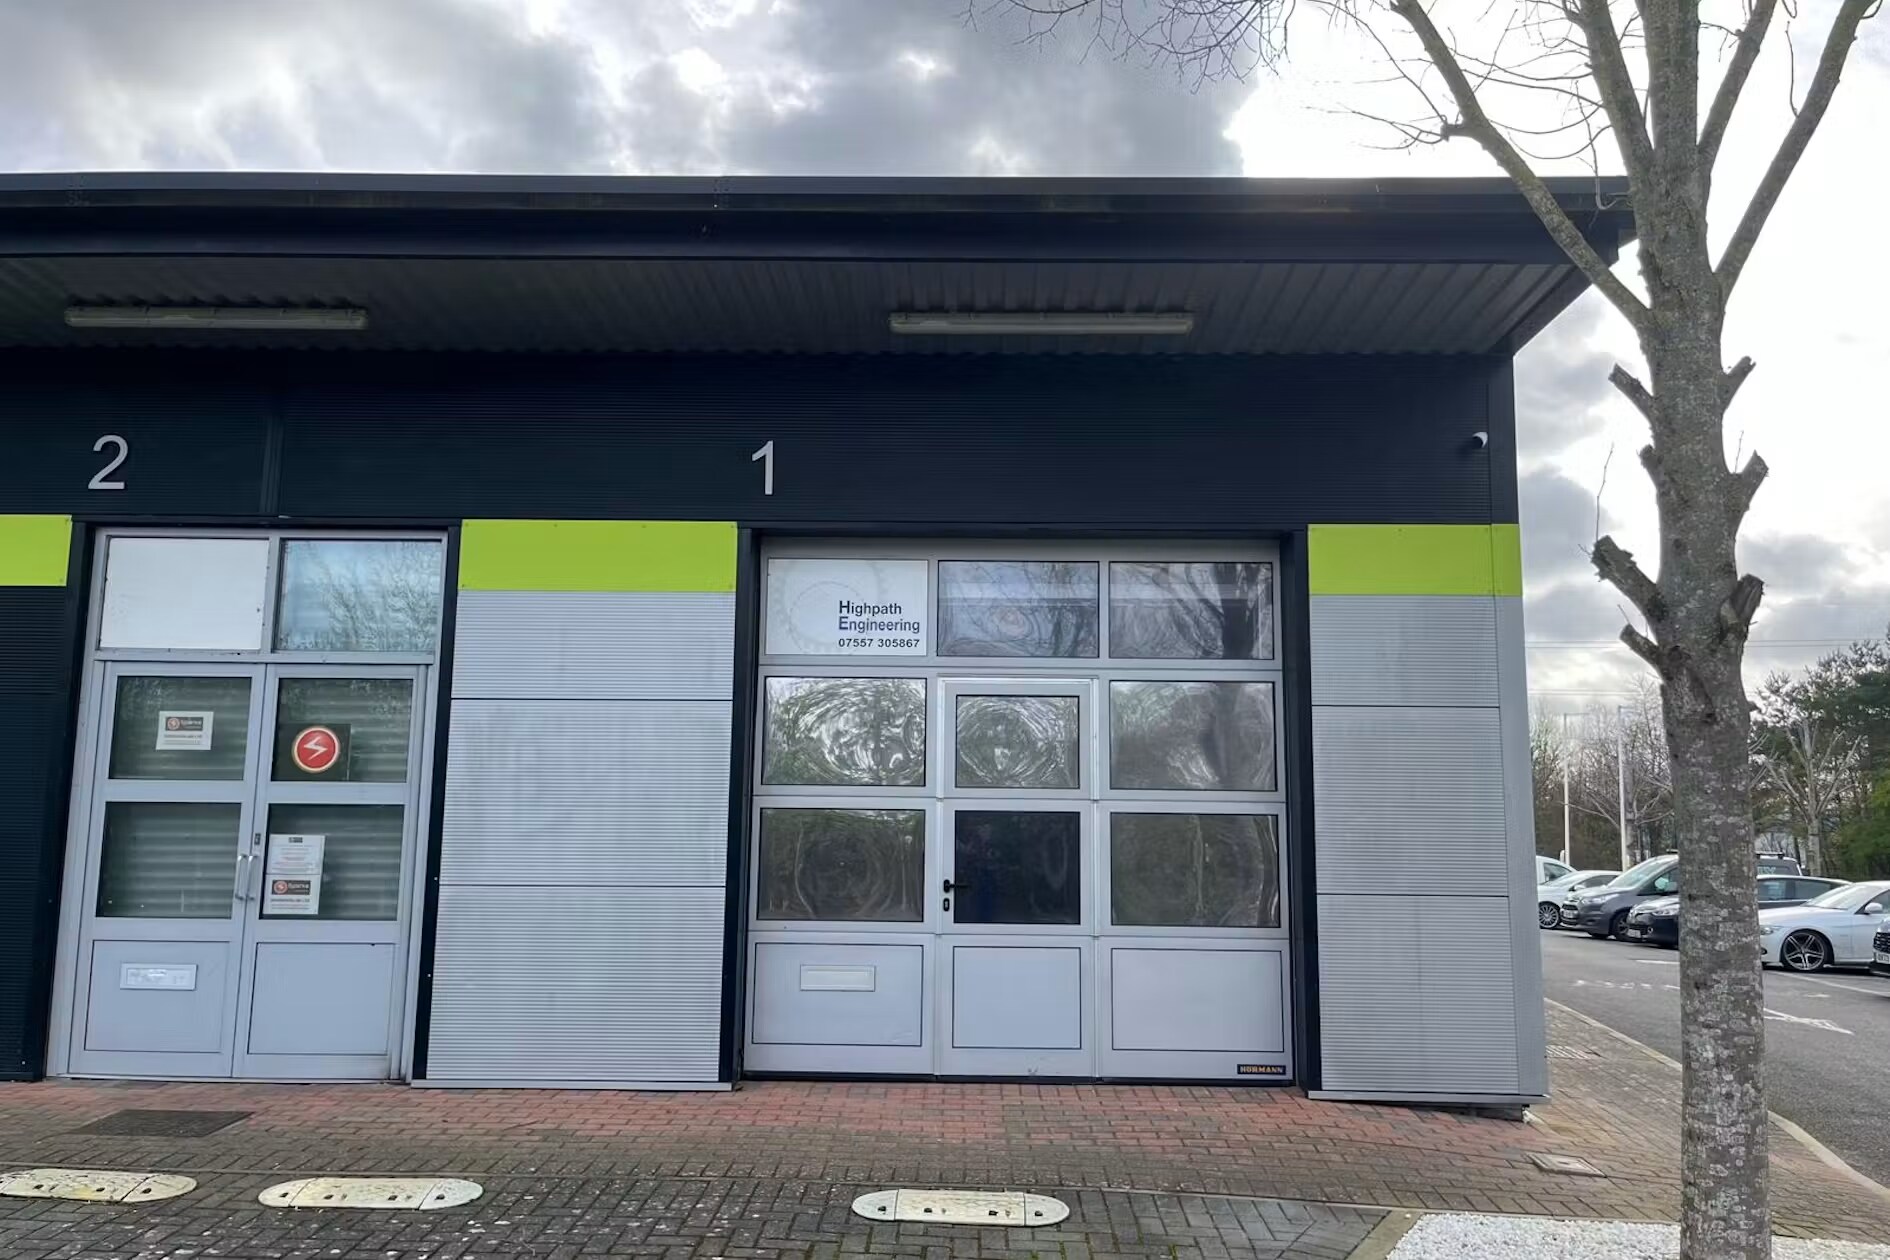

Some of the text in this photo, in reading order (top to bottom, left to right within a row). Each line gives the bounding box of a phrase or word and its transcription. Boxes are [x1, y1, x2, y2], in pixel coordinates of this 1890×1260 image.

[87, 434, 129, 490] 2
[751, 440, 774, 495] 1
[838, 600, 902, 617] Highpath
[838, 616, 920, 634] Engineering
[838, 638, 920, 648] 07557 305867
